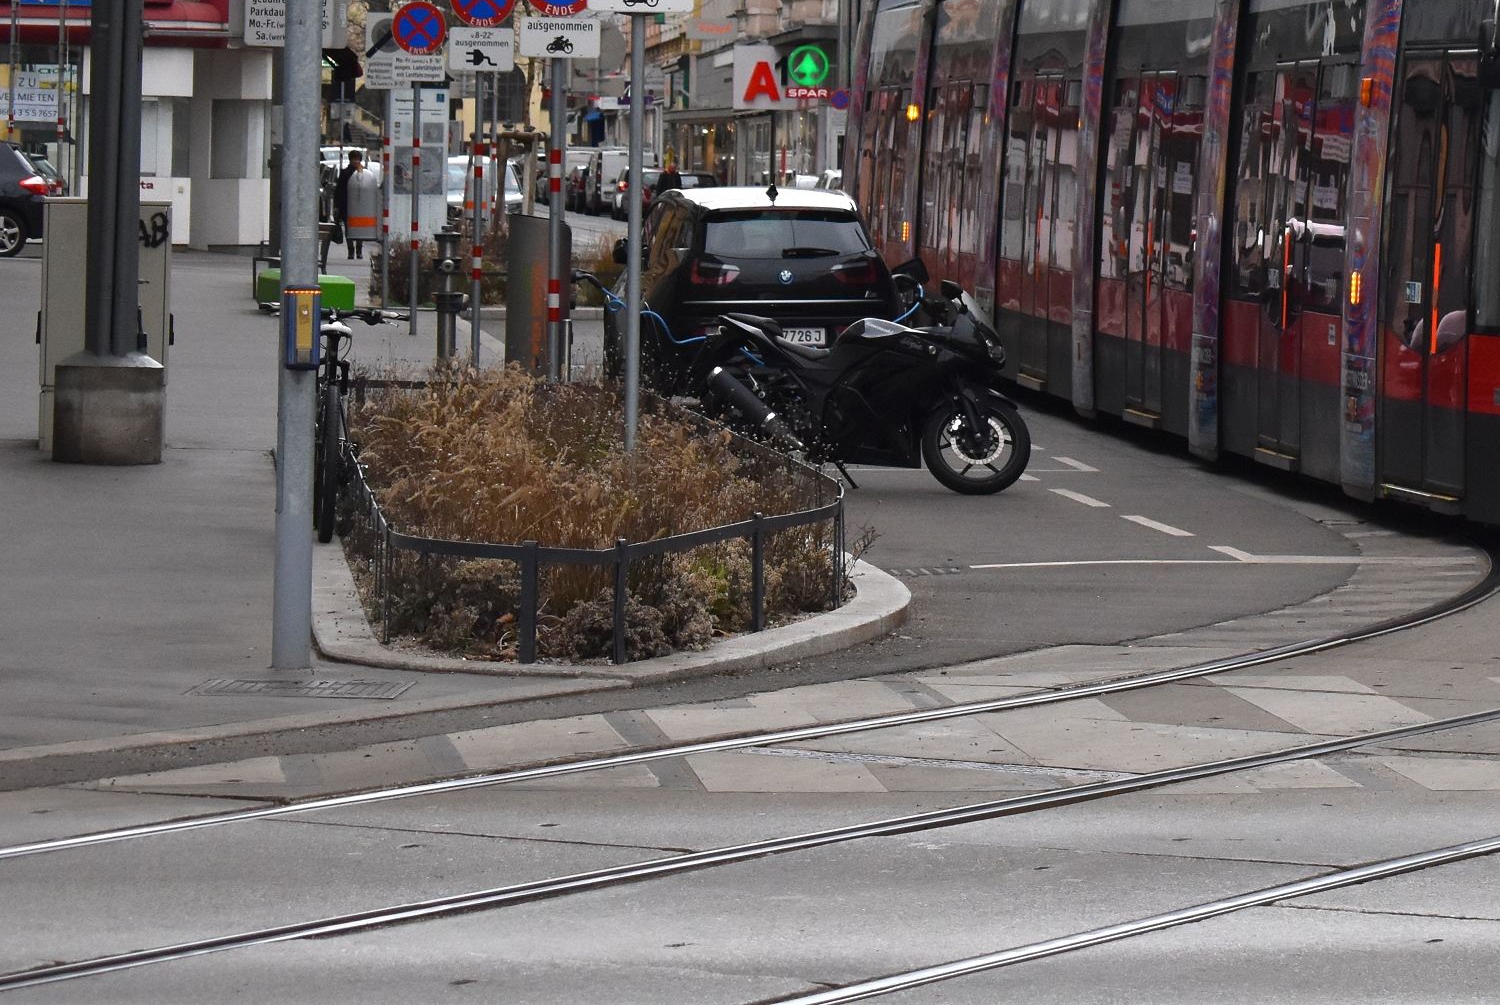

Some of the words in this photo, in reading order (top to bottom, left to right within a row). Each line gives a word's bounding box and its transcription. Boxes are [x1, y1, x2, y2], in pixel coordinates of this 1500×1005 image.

[545, 4, 576, 15] ENDE
[470, 17, 494, 26] ENDE
[527, 22, 593, 32] ausgenommen
[455, 40, 509, 48] ausgenommen
[743, 55, 788, 102] A1
[788, 88, 828, 97] SPAR
